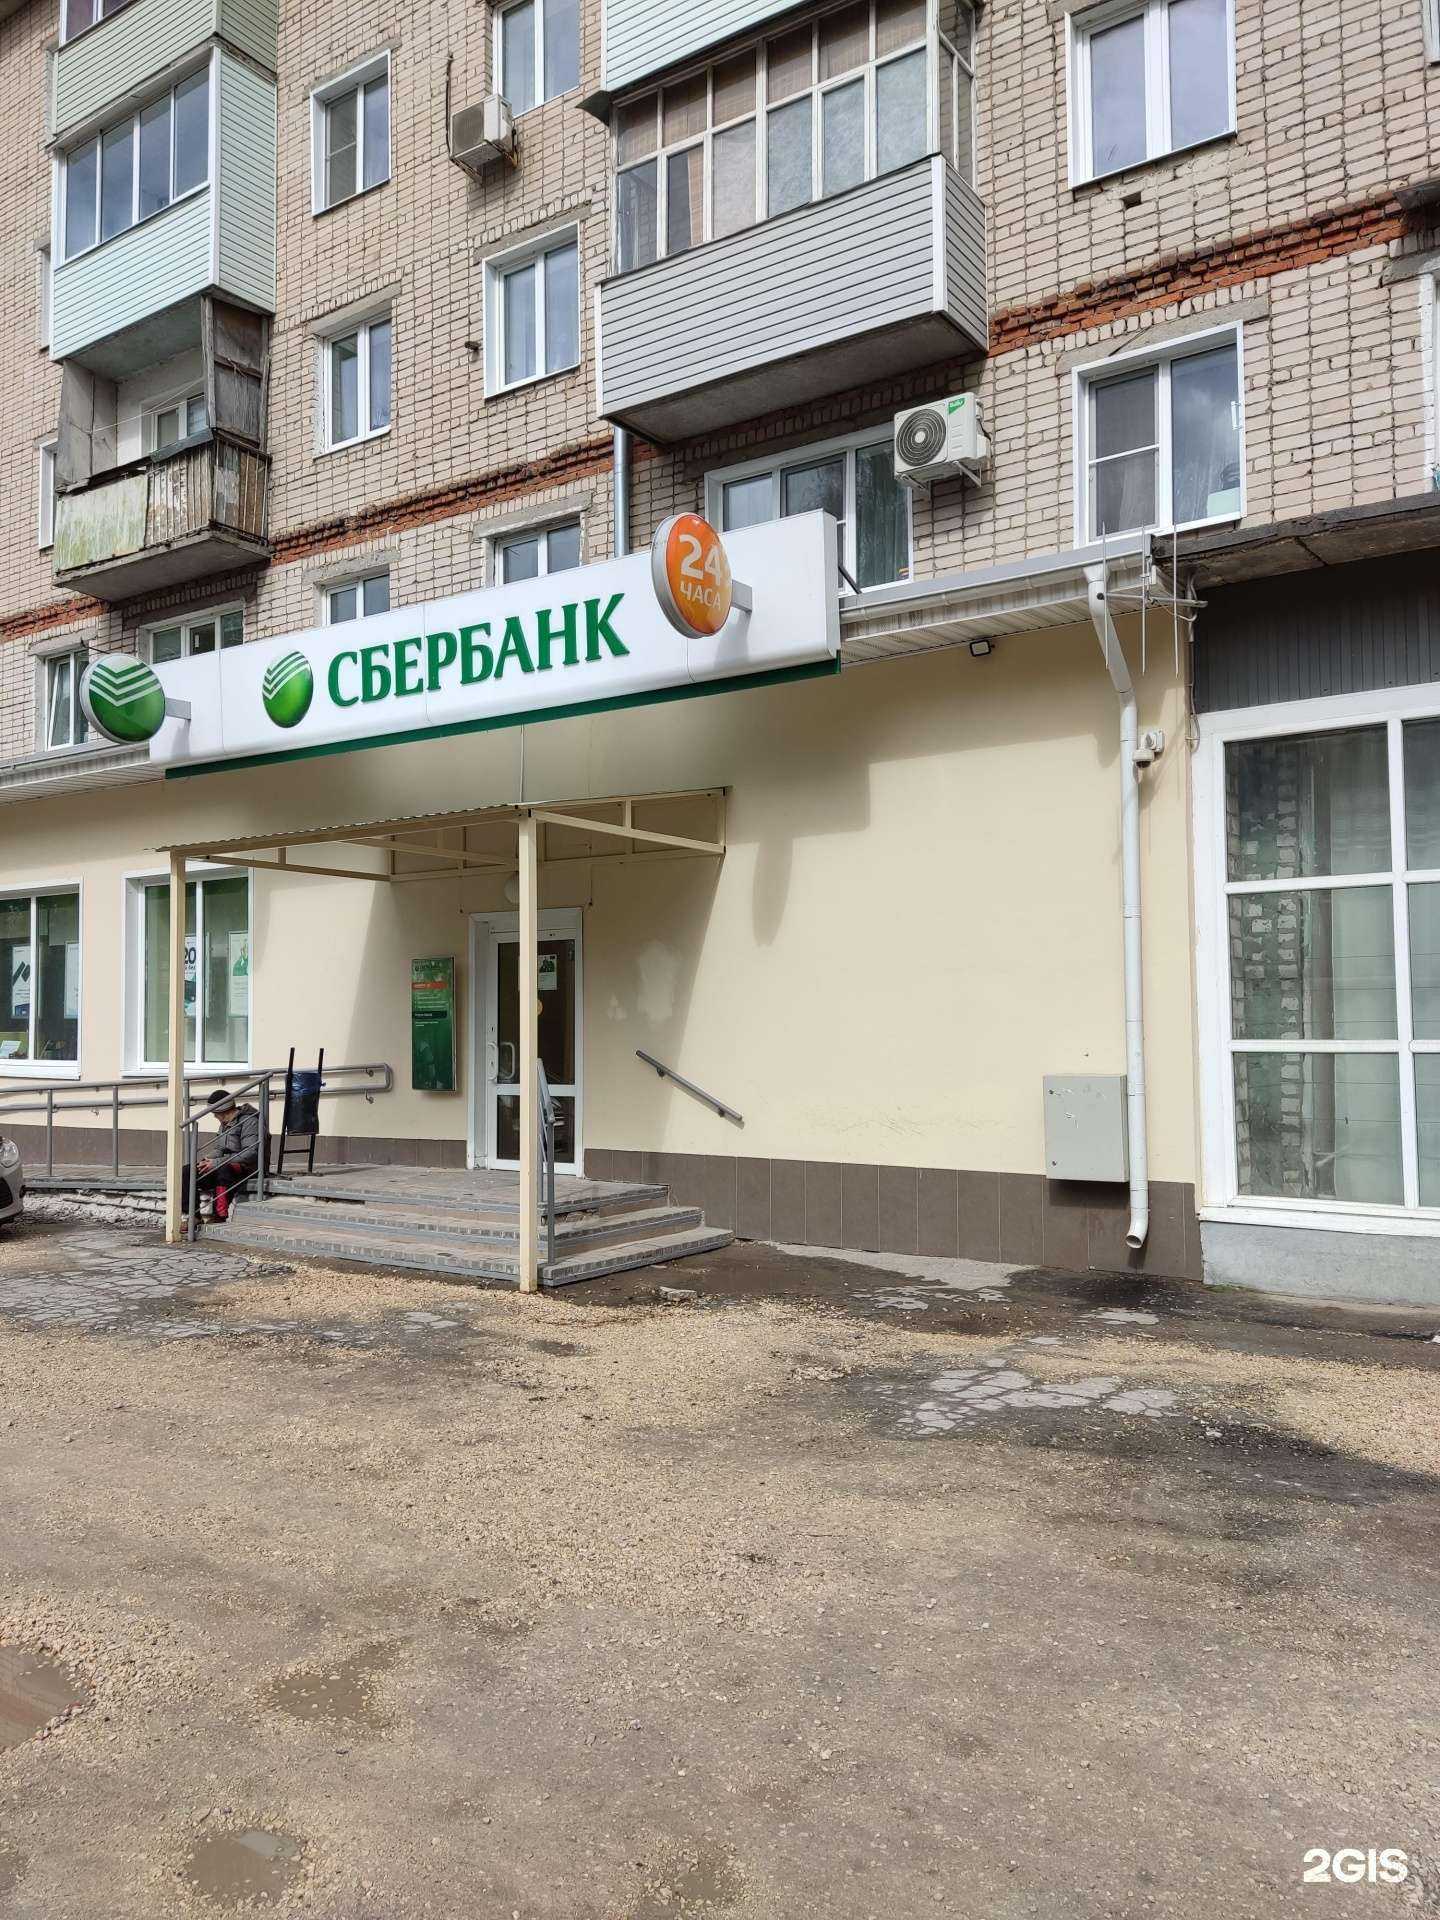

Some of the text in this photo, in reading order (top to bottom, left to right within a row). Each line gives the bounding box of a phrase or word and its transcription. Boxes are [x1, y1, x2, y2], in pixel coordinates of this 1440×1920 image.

[679, 534, 721, 586] 24
[680, 580, 721, 609] ЧАСА
[328, 593, 630, 706] СБЕРБАНК
